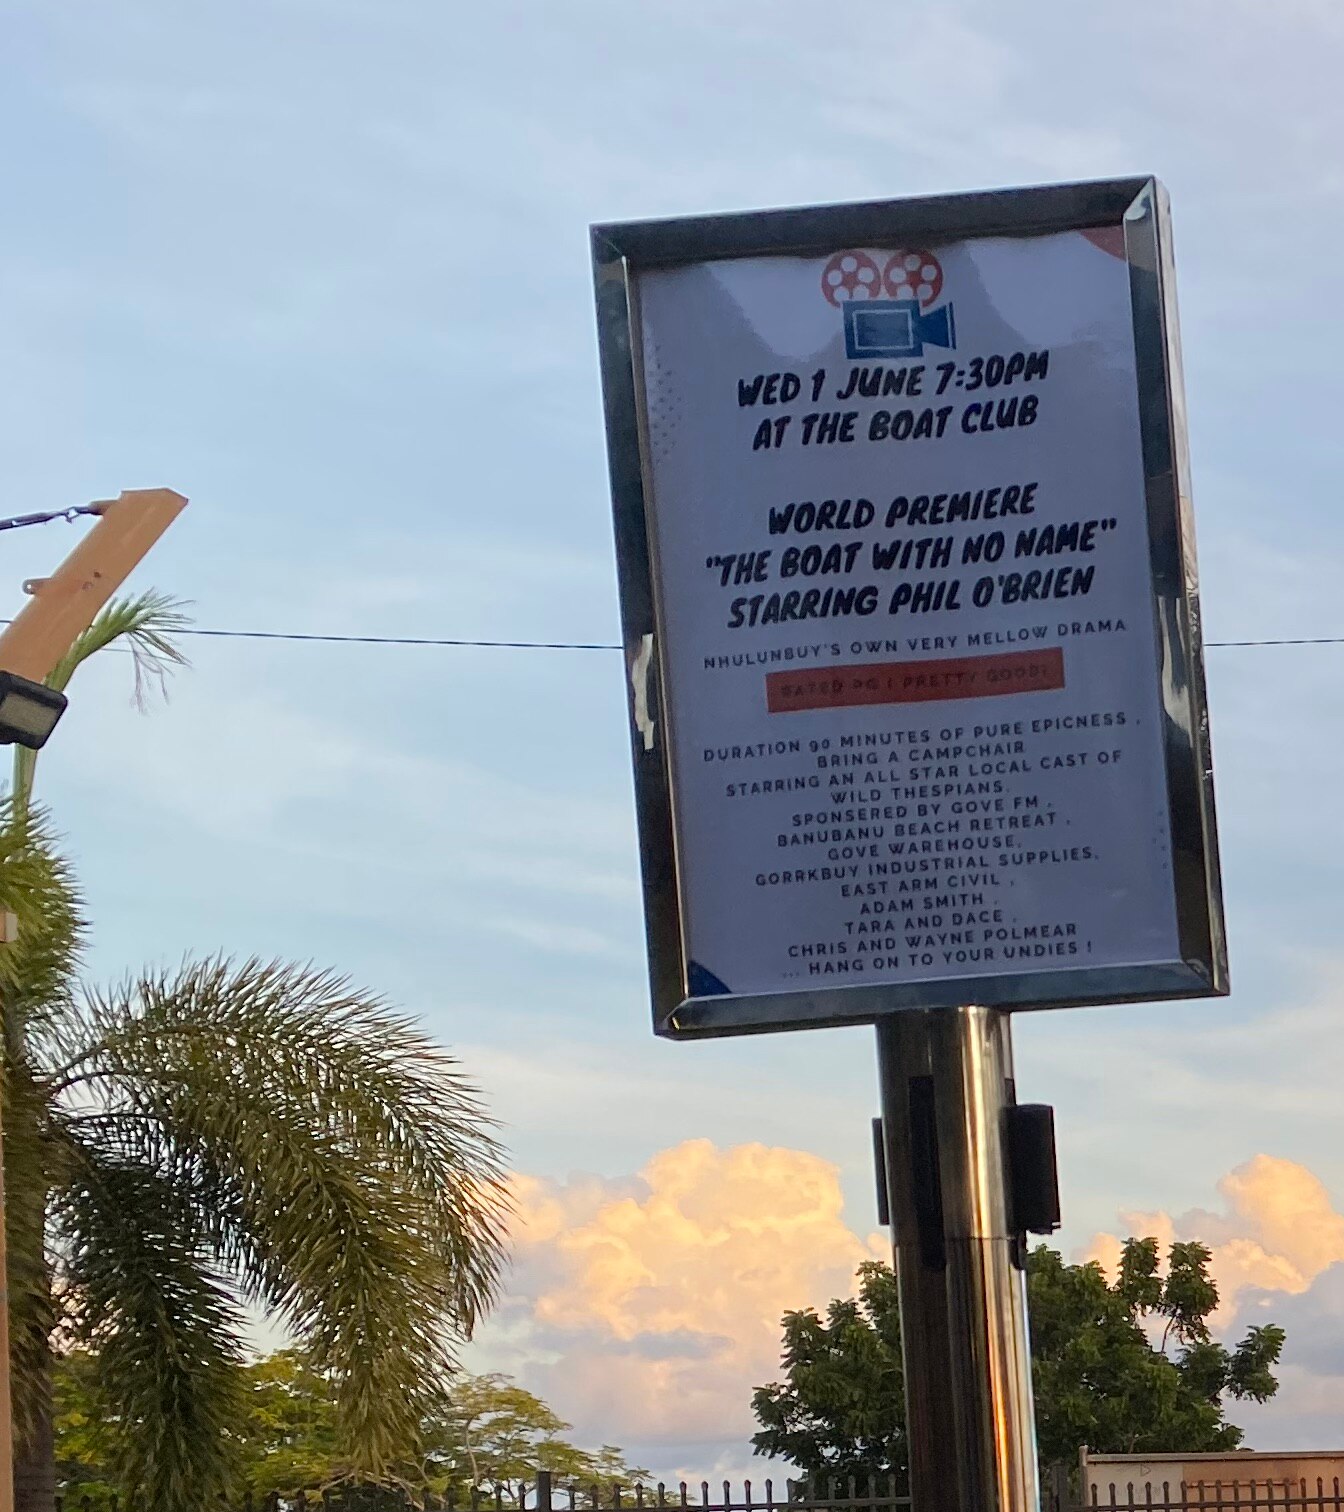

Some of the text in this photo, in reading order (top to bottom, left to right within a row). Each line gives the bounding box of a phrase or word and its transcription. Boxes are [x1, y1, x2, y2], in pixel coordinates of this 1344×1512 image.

[737, 349, 1050, 408] WED 1 JUNE 7:30PM
[752, 394, 1039, 451] AT THE BOAT CLUB
[768, 481, 1039, 535] WORLD PREMIERE
[705, 517, 1117, 587] "THE BOAT WITH NO NAME"
[727, 565, 1096, 629] STARRING PHIL O'BRIEN
[850, 639, 898, 655] OWN
[907, 635, 958, 652] VERY
[967, 625, 1048, 647] MELLOW
[1057, 619, 1126, 637] DRAMA
[703, 740, 800, 762] DURATION
[840, 729, 931, 748] MINUTES
[939, 727, 964, 742] OF
[973, 721, 1023, 739] PURE
[1031, 711, 1126, 733] EPICNESS
[817, 740, 1024, 769] BRING A CAMPCHAIR
[726, 749, 1122, 797] STARRING AN ALL STAR LOCAL CAST OF
[792, 795, 1038, 827] SPONSERED BY GOVE FM
[830, 788, 882, 805] WILD
[777, 811, 1056, 848] BANUBANU BEACH RETREAT
[827, 844, 879, 861] GOVE
[868, 855, 989, 877] INDUSTRIAL
[841, 873, 1000, 898] EAST ARM CIVIL
[860, 892, 984, 915] ADAM SMITH
[844, 909, 1003, 935] TARA AND DACE
[787, 923, 1077, 958] CHRIS AND WAYNE POLMEAR
[808, 941, 1078, 976] HANG ON TO YOUR UNDIES
